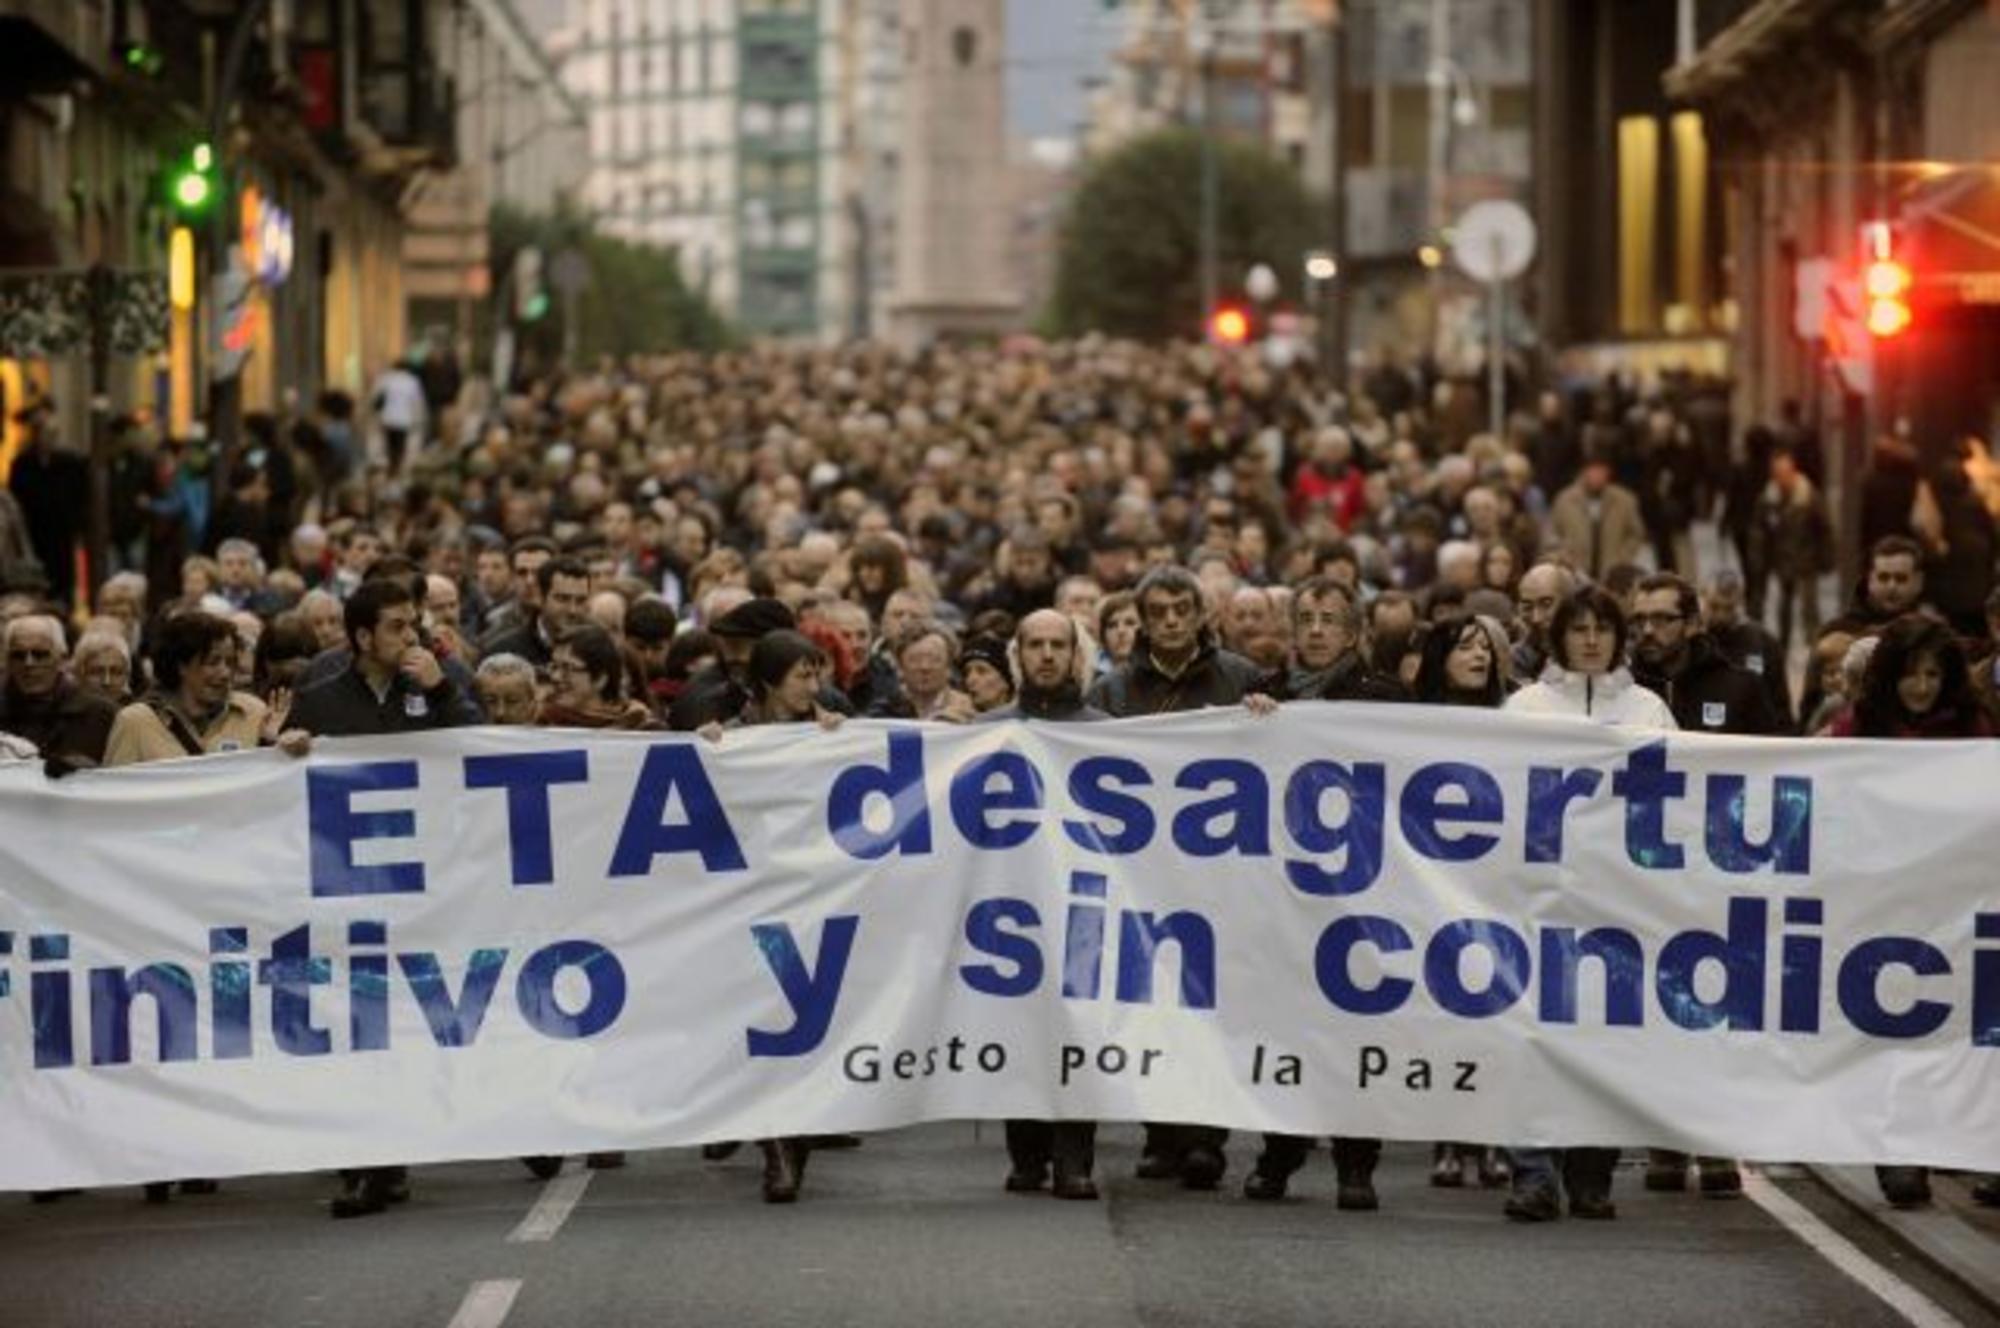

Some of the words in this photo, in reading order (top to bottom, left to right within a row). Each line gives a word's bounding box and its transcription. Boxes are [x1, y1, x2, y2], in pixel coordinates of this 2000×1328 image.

[303, 742, 747, 900] ETA
[825, 728, 1813, 897] desagertu
[746, 914, 861, 1059] y
[959, 871, 1217, 1010] sin
[843, 1036, 1007, 1083] Gesto
[1061, 1044, 1164, 1087] por
[1251, 1044, 1302, 1086] la
